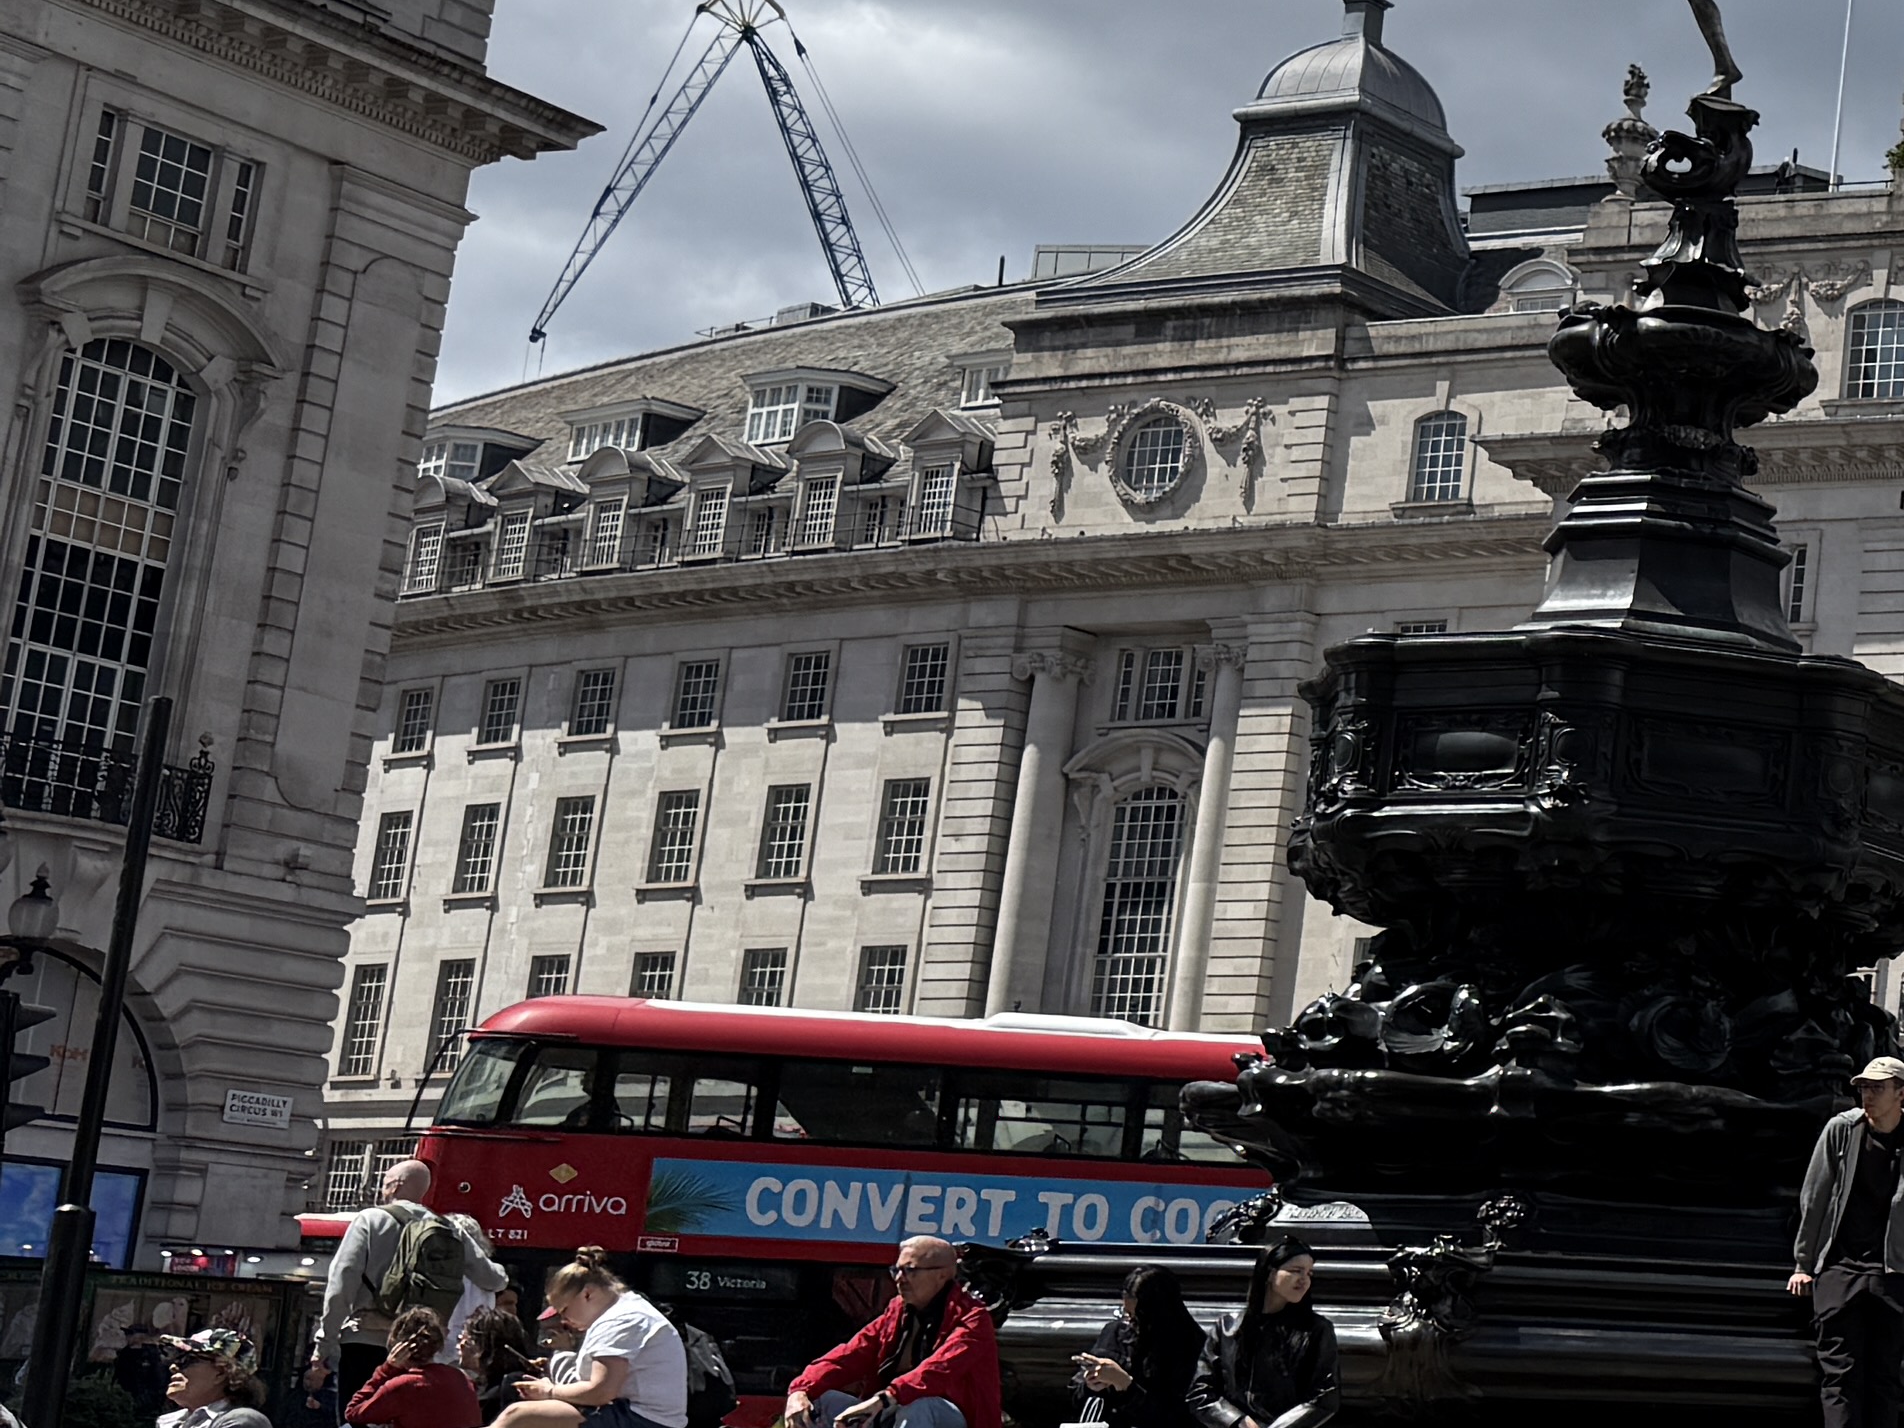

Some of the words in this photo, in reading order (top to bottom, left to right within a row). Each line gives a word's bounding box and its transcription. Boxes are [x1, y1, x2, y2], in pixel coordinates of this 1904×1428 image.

[229, 1103, 268, 1117] CIRCUS
[231, 1093, 288, 1109] PICCADILLY
[538, 1189, 627, 1215] arriva
[745, 1176, 1016, 1237] CONVERT
[1038, 1191, 1109, 1241] TO
[685, 1270, 712, 1290] 38
[717, 1276, 767, 1290] Victoria
